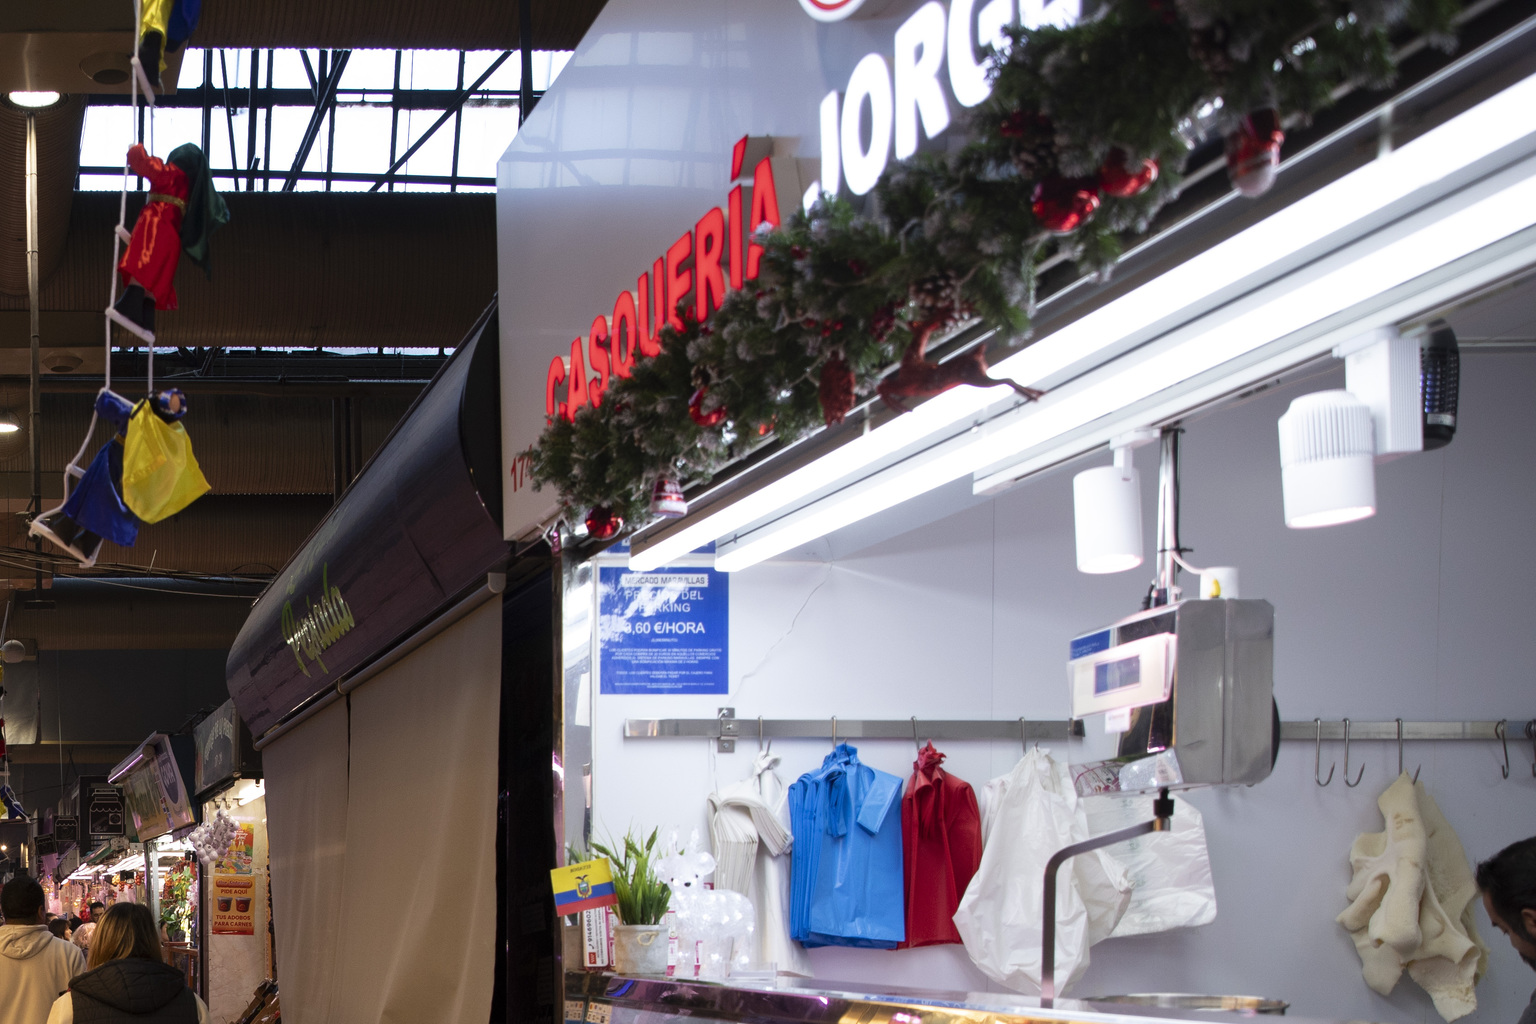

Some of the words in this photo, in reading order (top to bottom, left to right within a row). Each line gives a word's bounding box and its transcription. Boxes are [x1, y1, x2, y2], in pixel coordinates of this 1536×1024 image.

[546, 134, 781, 425] CASQUERÍA
[625, 577, 658, 585] MERCADO
[660, 577, 705, 585] MARAVILLAS
[681, 590, 704, 600] DEL
[639, 603, 691, 613] PRKING
[654, 621, 706, 634] €/HORA
